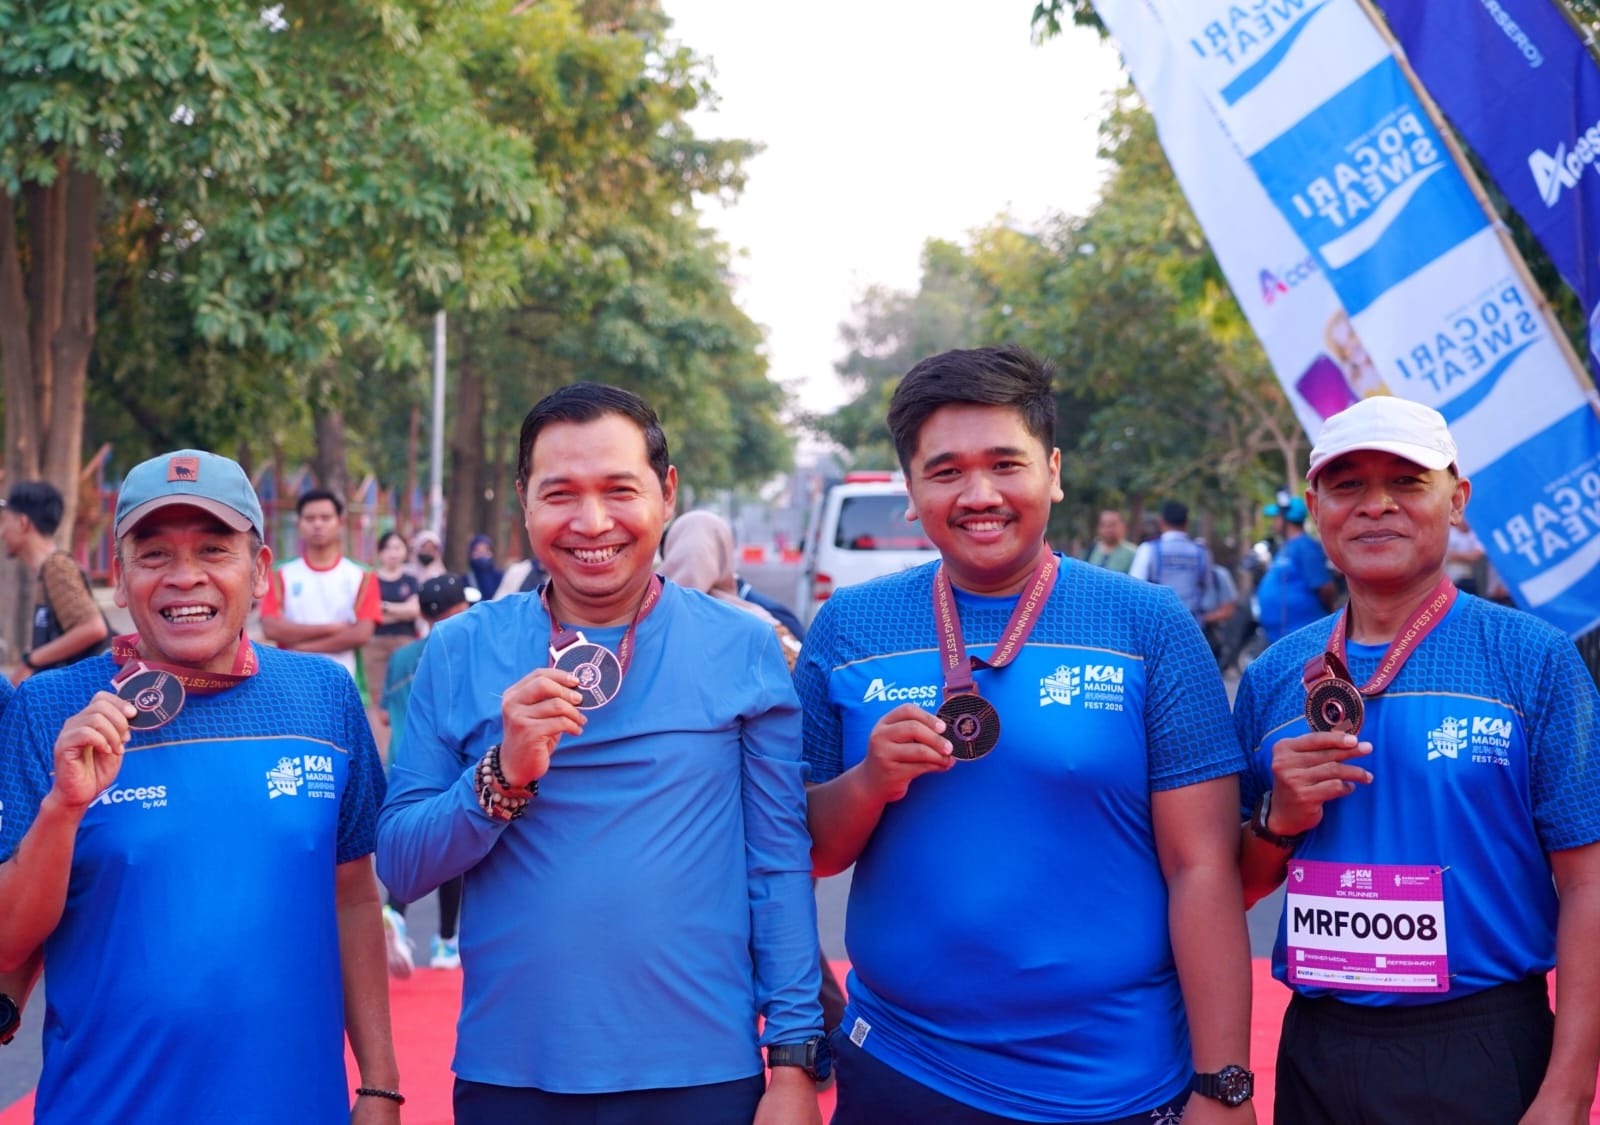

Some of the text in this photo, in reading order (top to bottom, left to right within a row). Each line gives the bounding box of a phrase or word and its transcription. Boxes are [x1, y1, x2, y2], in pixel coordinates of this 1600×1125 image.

[1011, 602, 1035, 643] RUNNING
[1030, 581, 1044, 605] FEST
[1041, 562, 1053, 581] 2026
[1384, 629, 1416, 674] RUNNING
[1414, 610, 1433, 632] FEST
[1430, 593, 1448, 611] 2026
[945, 633, 958, 655] FEST
[1084, 664, 1124, 684] KAI
[862, 678, 938, 703] Access
[1084, 683, 1124, 693] MADIUN
[1084, 701, 1124, 711] FEST 2026
[1471, 716, 1512, 739] KAI
[303, 755, 333, 772] KAI
[1472, 755, 1492, 763] FEST
[305, 772, 334, 782] MADIUN
[307, 790, 322, 798] FEST
[142, 799, 168, 810] by KAI
[1293, 906, 1438, 941] MRF0008
